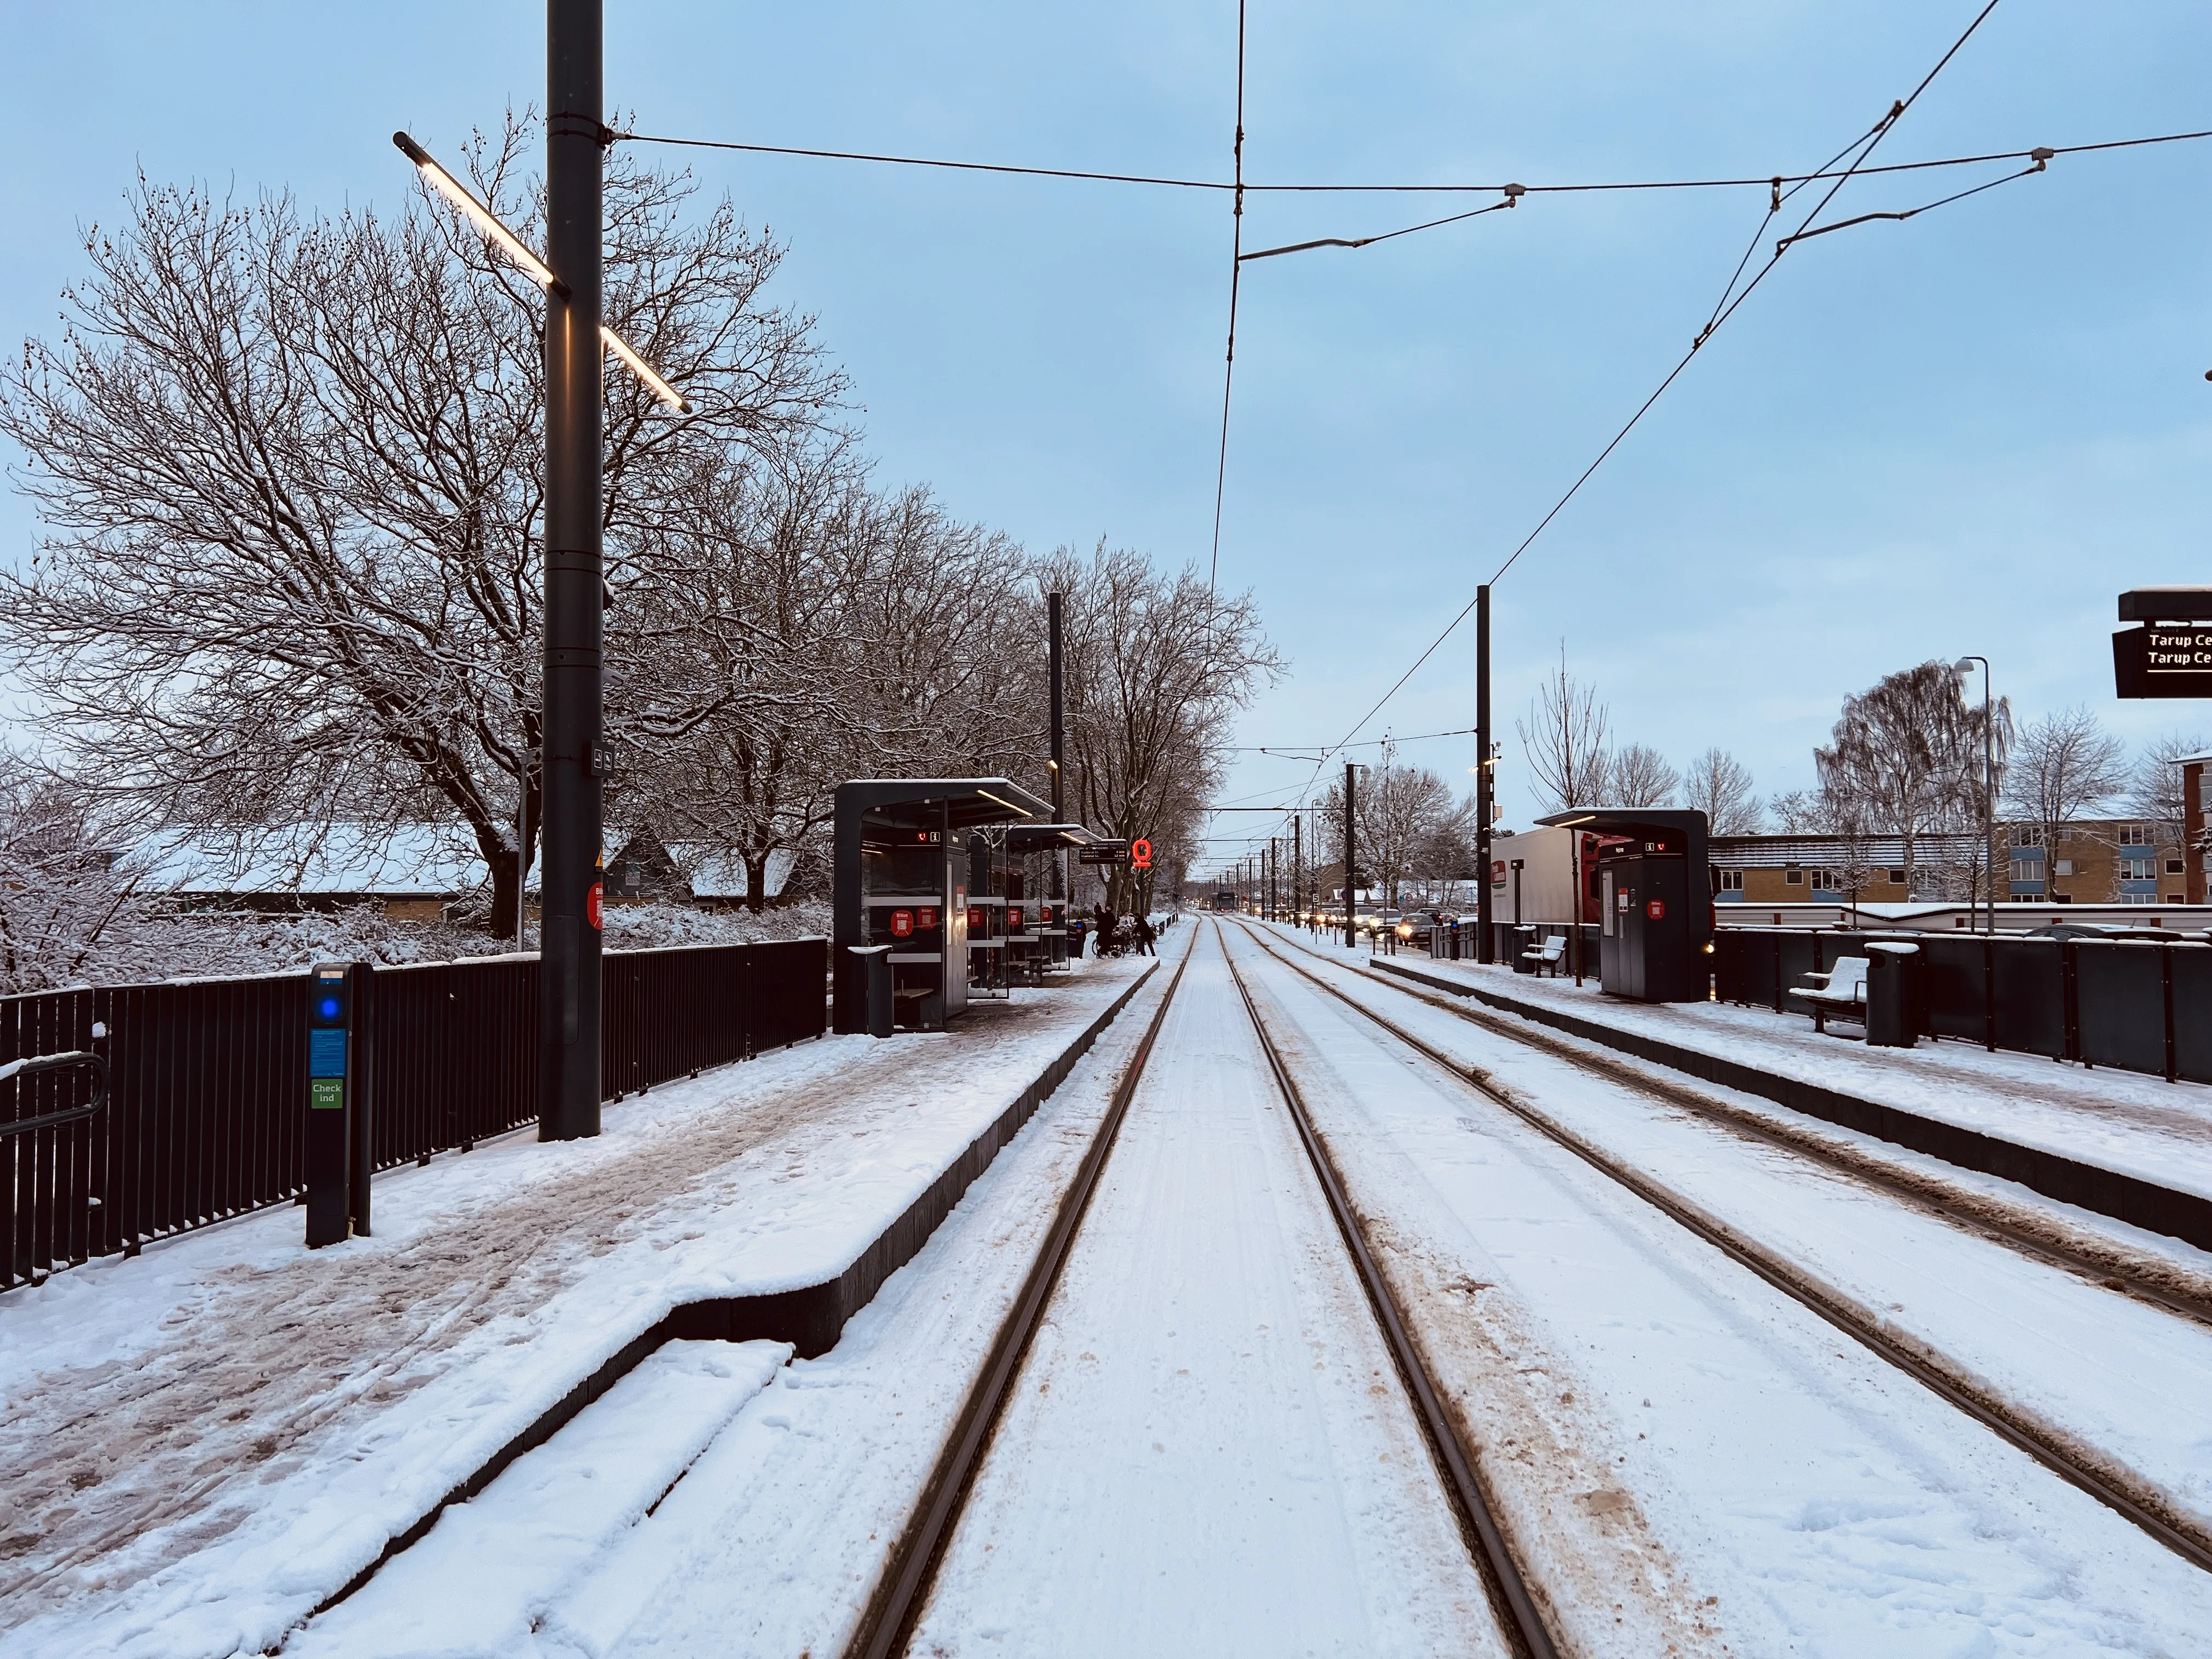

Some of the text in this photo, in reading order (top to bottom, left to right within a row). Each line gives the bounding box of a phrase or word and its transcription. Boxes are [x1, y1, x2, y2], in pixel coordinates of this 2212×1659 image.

[2149, 634, 2192, 647] Tarup
[2148, 651, 2212, 665] Tarup Ce
[313, 1084, 341, 1092] Check
[320, 1093, 334, 1102] ind
